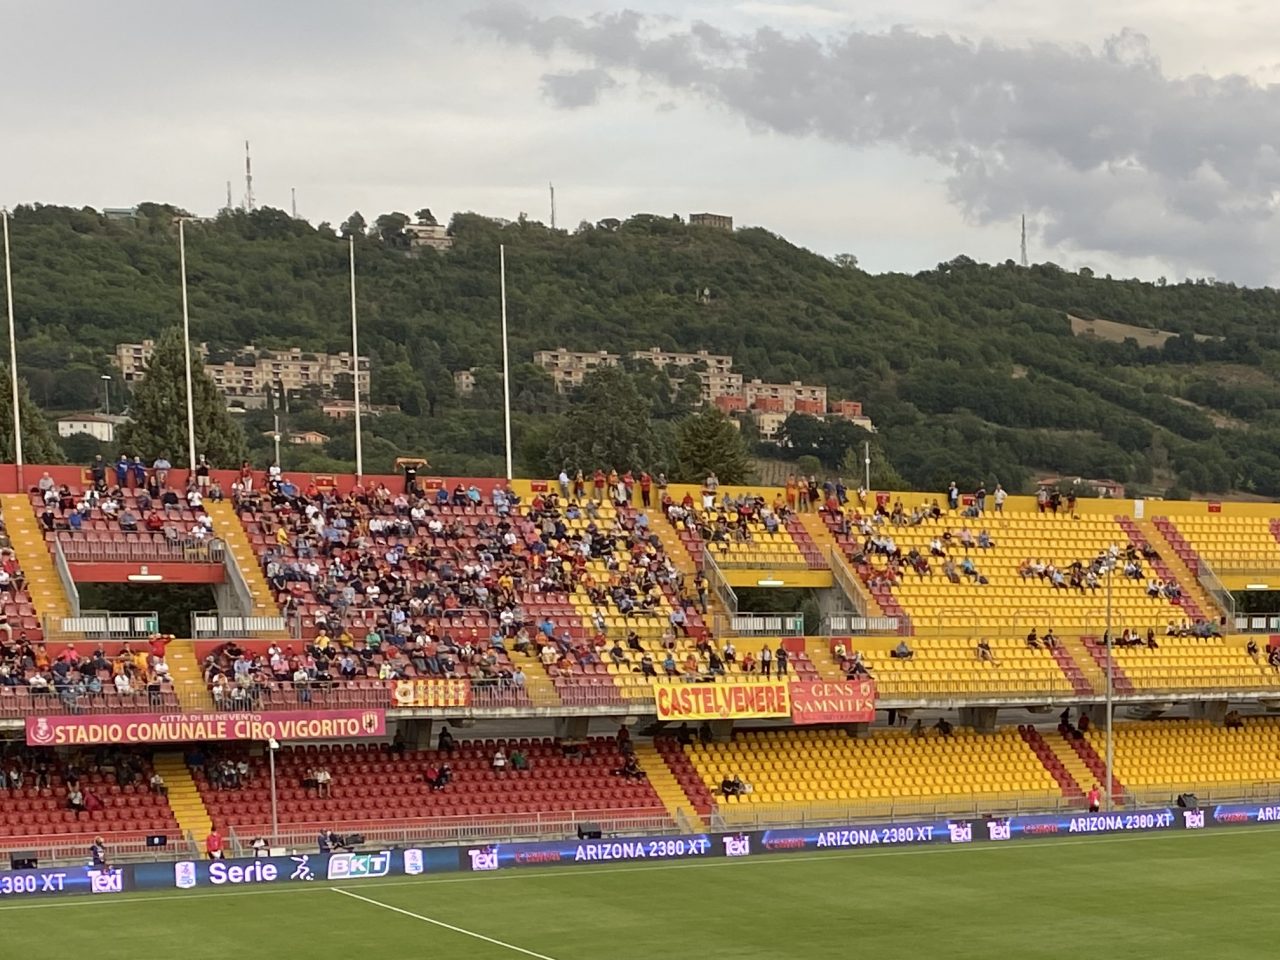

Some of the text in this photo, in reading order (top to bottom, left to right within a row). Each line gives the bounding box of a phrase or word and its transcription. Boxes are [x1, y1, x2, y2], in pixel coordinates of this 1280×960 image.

[811, 683, 853, 697] GENS
[657, 686, 787, 716] CASTELVENERE
[793, 698, 873, 713] SAMNITES
[203, 713, 261, 722] BENEVENTO
[55, 718, 360, 744] STADIO COMUNALE CIRO VIGORITO
[1069, 815, 1124, 832] ARIZONA
[1156, 813, 1171, 827] XT
[723, 836, 749, 857] Texi
[817, 830, 879, 847] ARIZONA
[917, 826, 934, 841] XT
[468, 849, 498, 871] Texi
[575, 842, 645, 861] ARIZONA
[688, 839, 706, 854] XT
[208, 860, 278, 884] Serie
[332, 856, 386, 873] BKT
[0, 873, 66, 894] 380 XT
[88, 868, 122, 893] Texi
